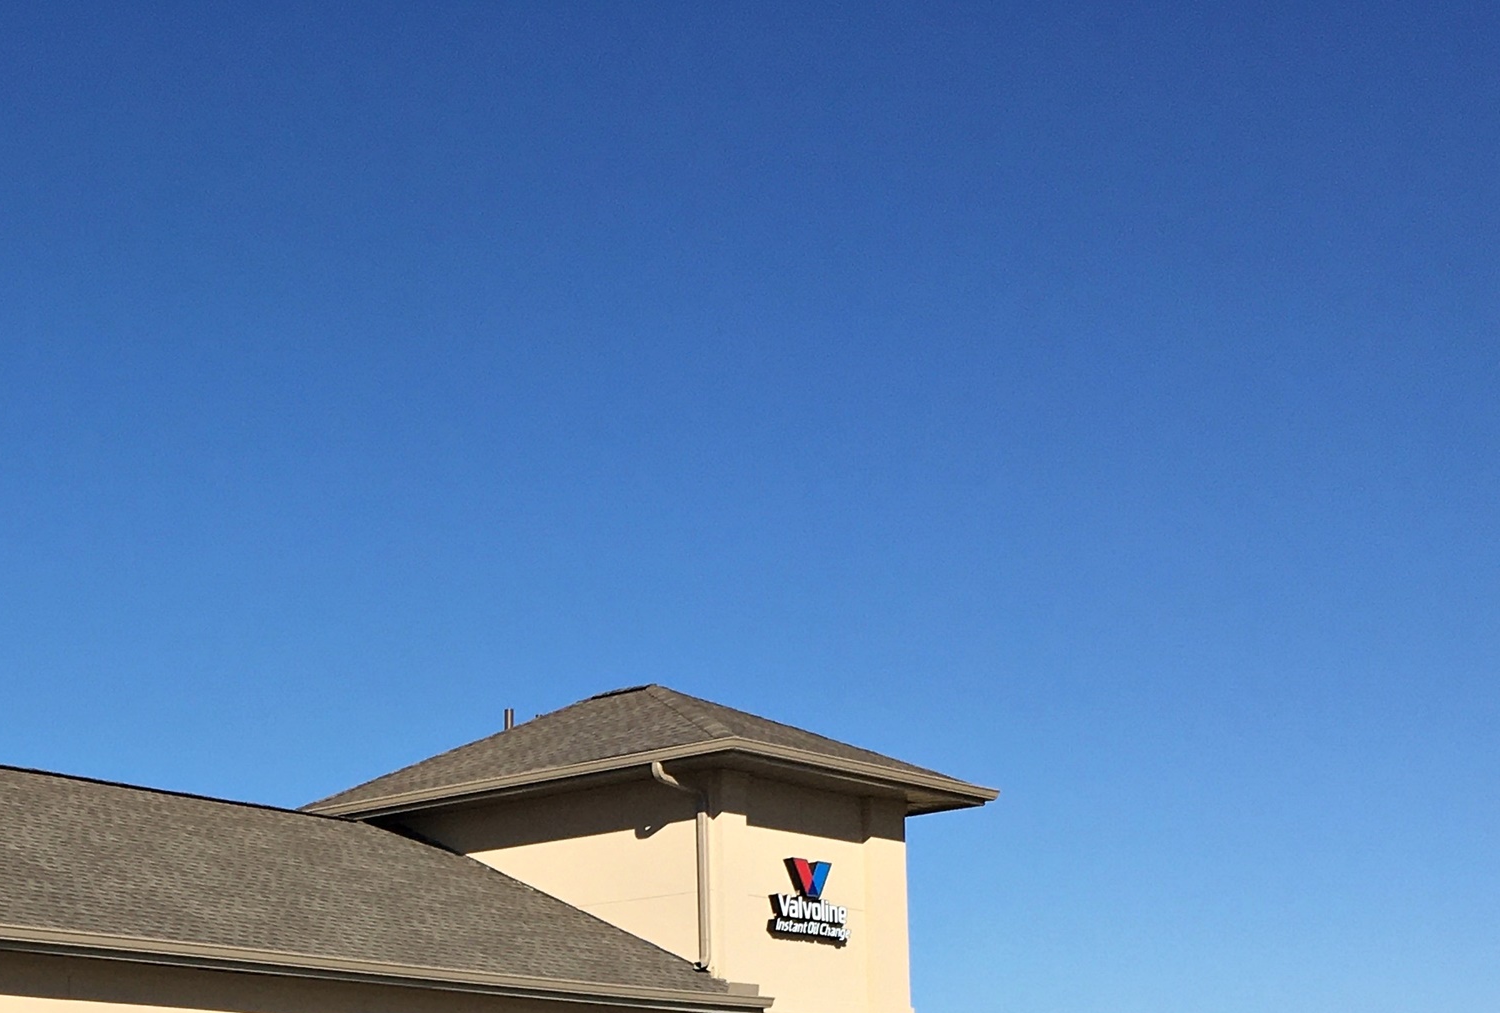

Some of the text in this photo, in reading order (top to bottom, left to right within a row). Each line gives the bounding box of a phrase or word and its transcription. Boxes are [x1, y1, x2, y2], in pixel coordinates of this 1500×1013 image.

[777, 893, 847, 924] Valvoline
[775, 917, 851, 941] Instant Oil Change
